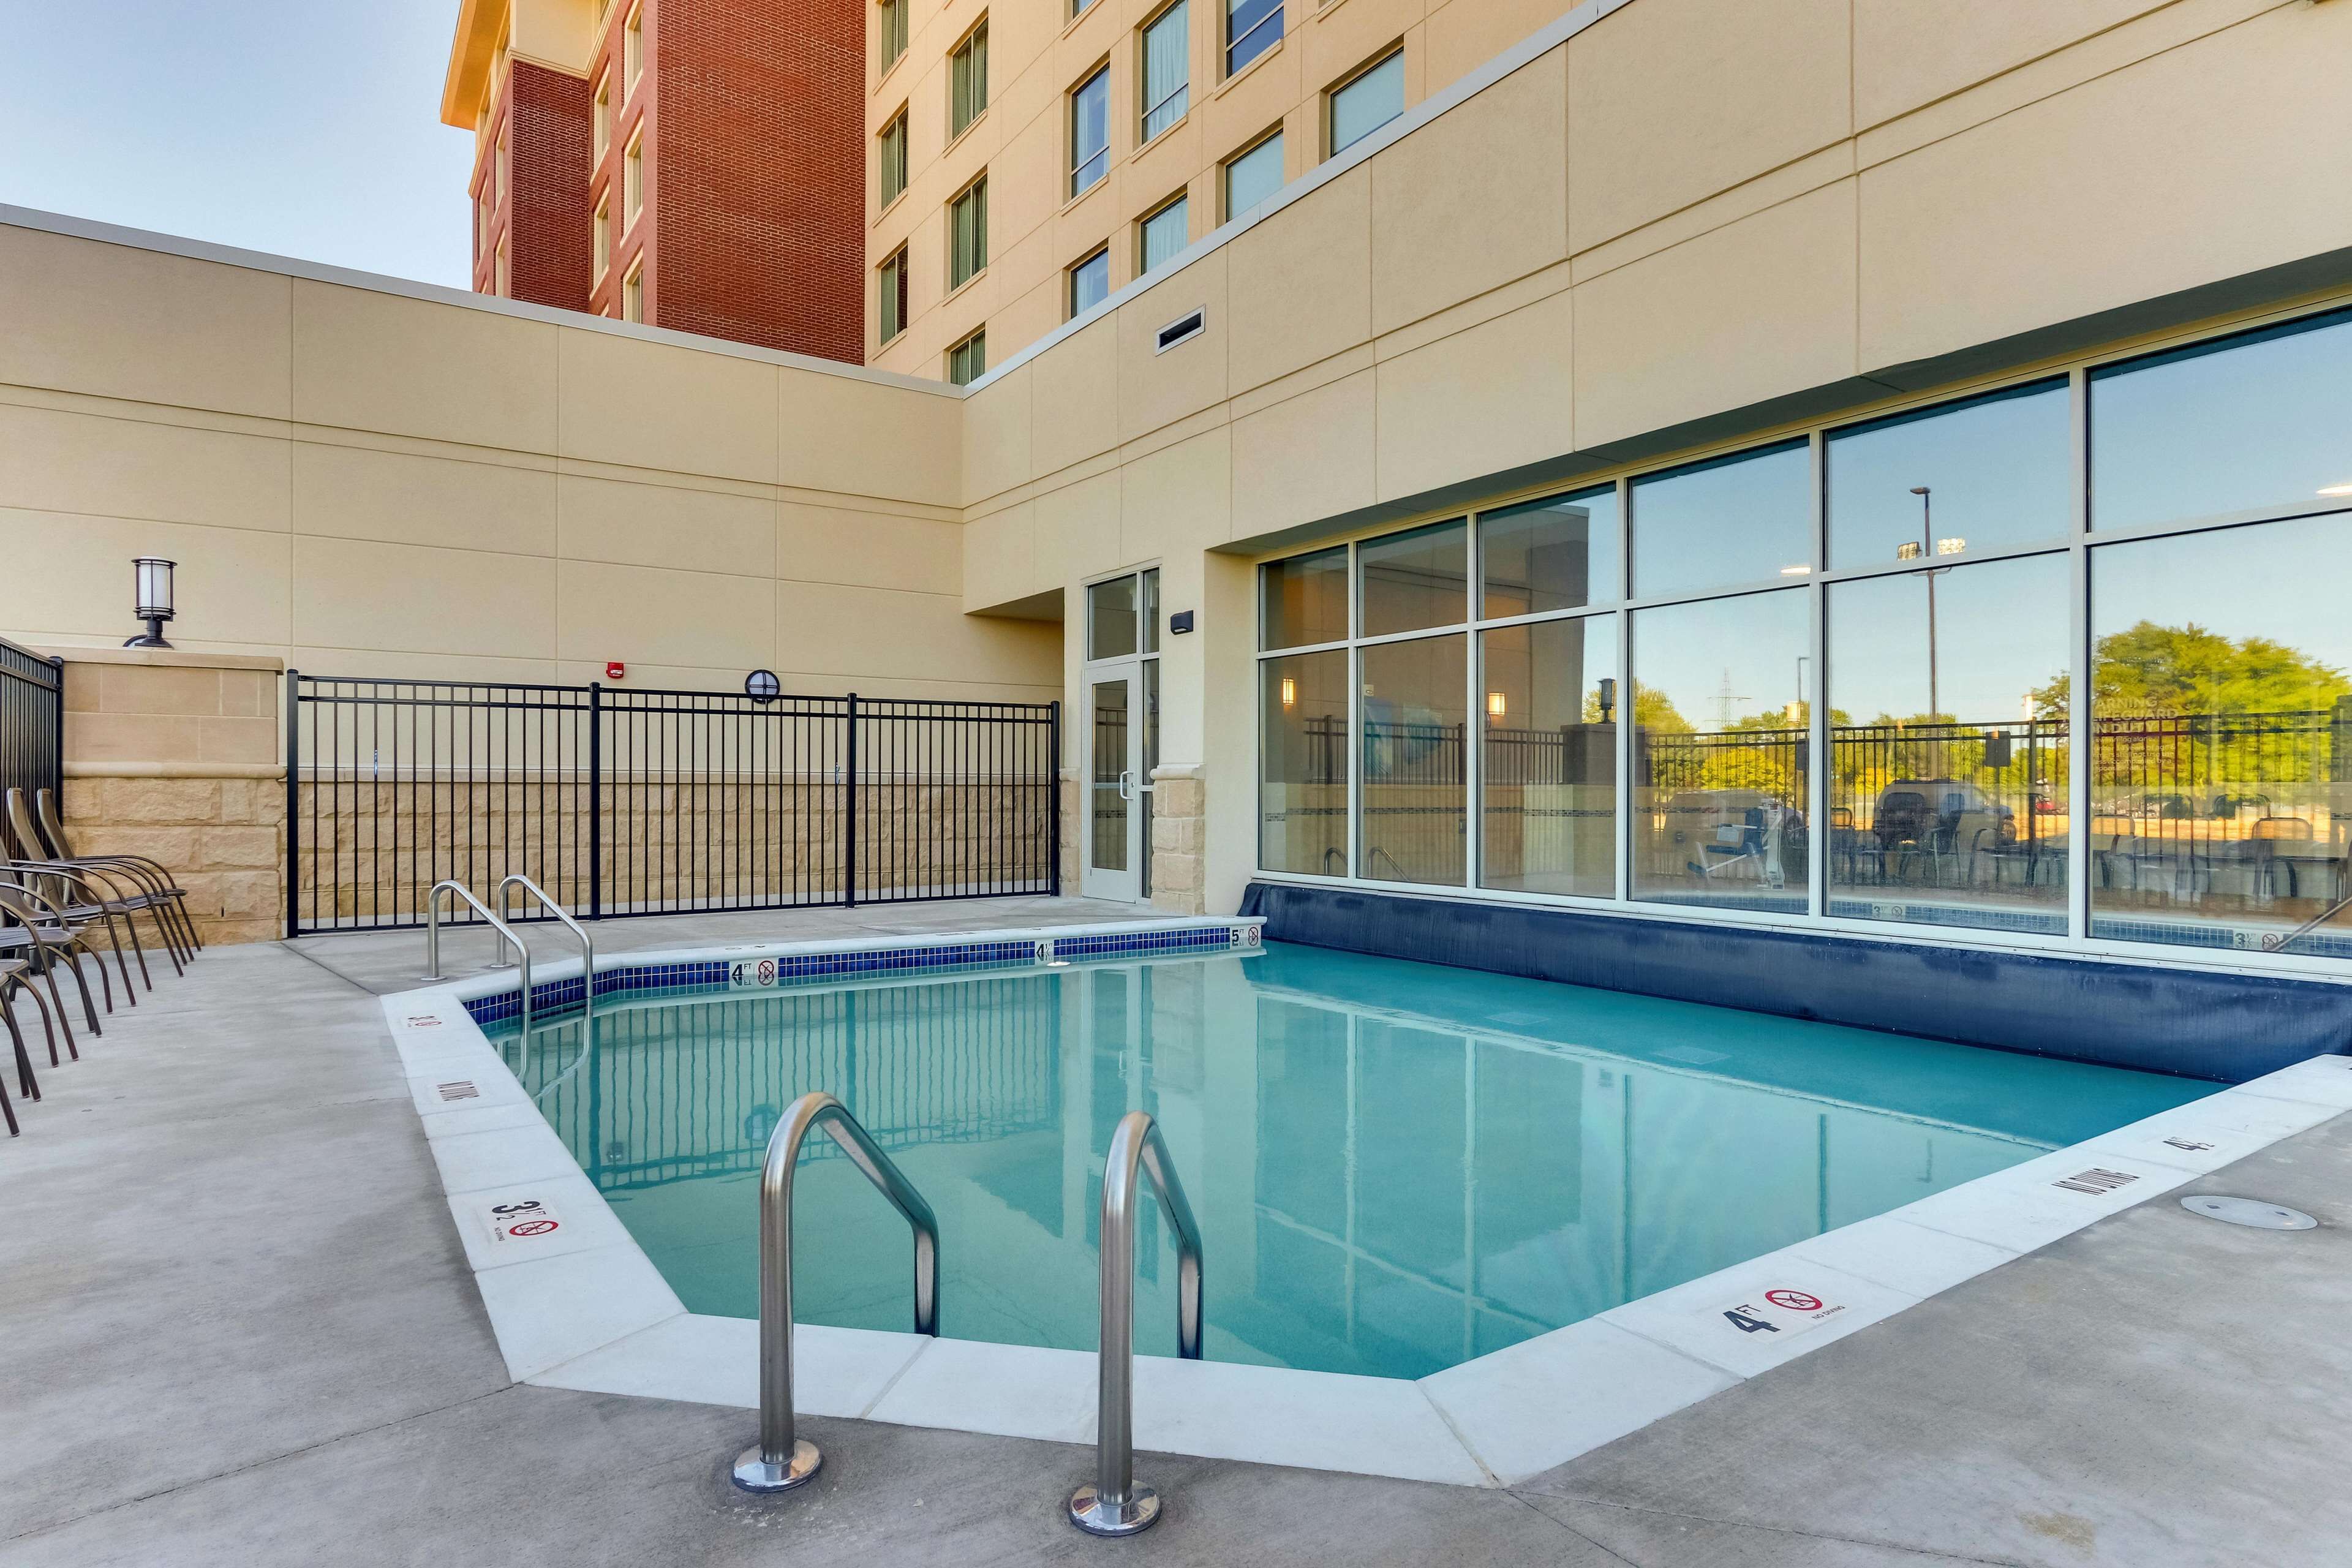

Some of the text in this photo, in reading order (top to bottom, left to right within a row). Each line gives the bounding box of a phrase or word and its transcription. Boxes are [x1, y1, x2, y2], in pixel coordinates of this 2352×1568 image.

[2095, 696, 2157, 709] ARNING
[2162, 1140, 2209, 1151] 4
[2050, 1167, 2142, 1196] NO DIVING
[492, 1200, 540, 1213] 3
[1822, 1305, 1845, 1316] DIVING
[1722, 1303, 1782, 1333] 4 FT
